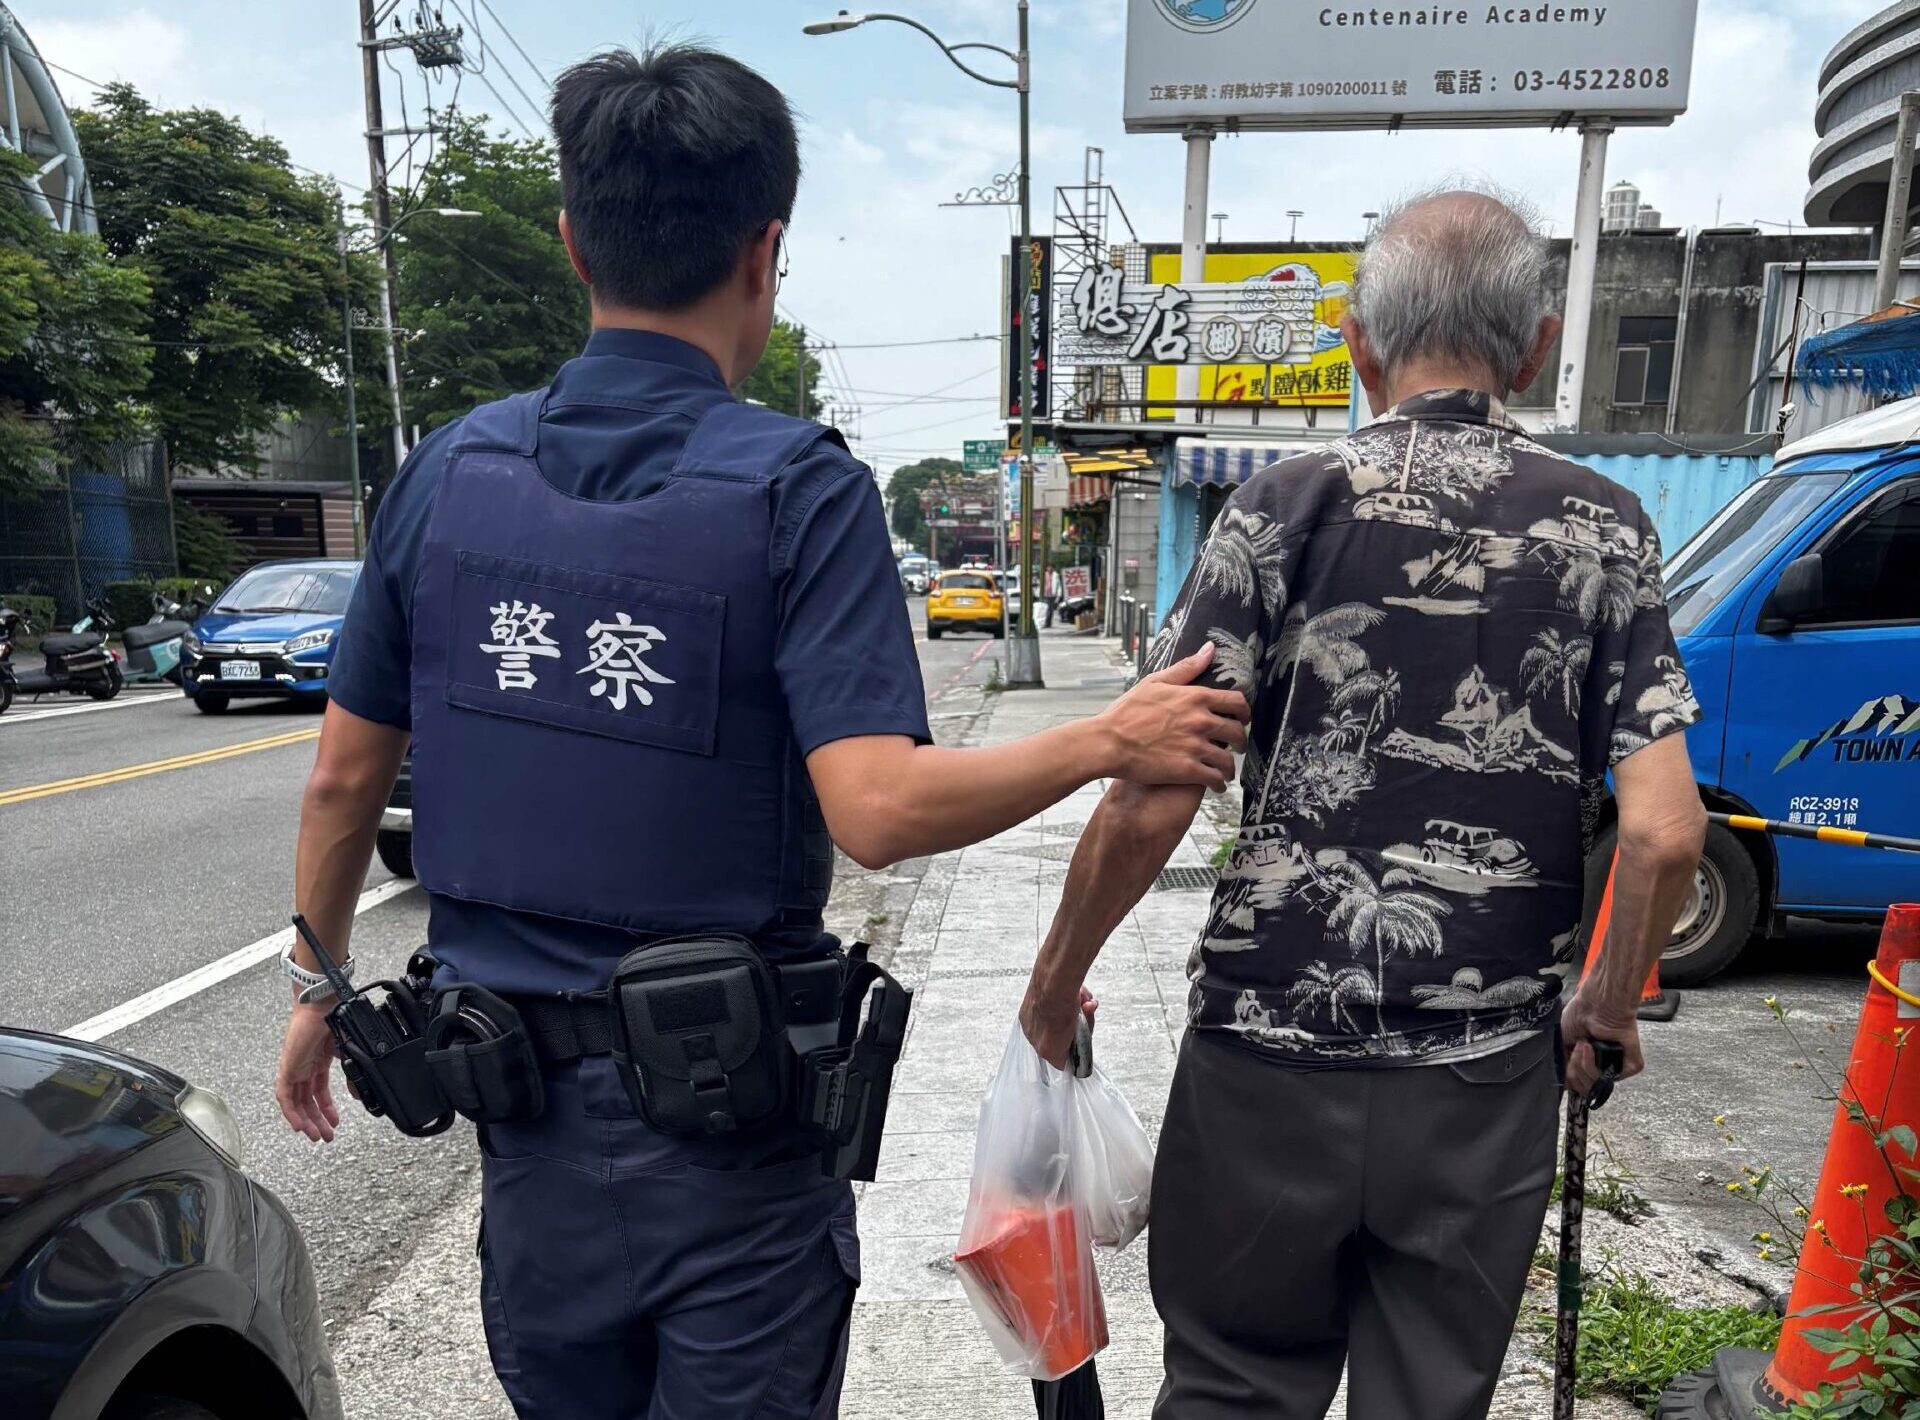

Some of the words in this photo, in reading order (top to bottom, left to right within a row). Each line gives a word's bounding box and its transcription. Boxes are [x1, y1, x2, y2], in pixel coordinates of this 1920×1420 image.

[1319, 5, 1468, 26] Centenaire
[1485, 4, 1607, 26] Academy
[1514, 67, 1670, 91] 03-4522808
[479, 600, 676, 710] 警察
[1832, 738, 1905, 763] TOWN
